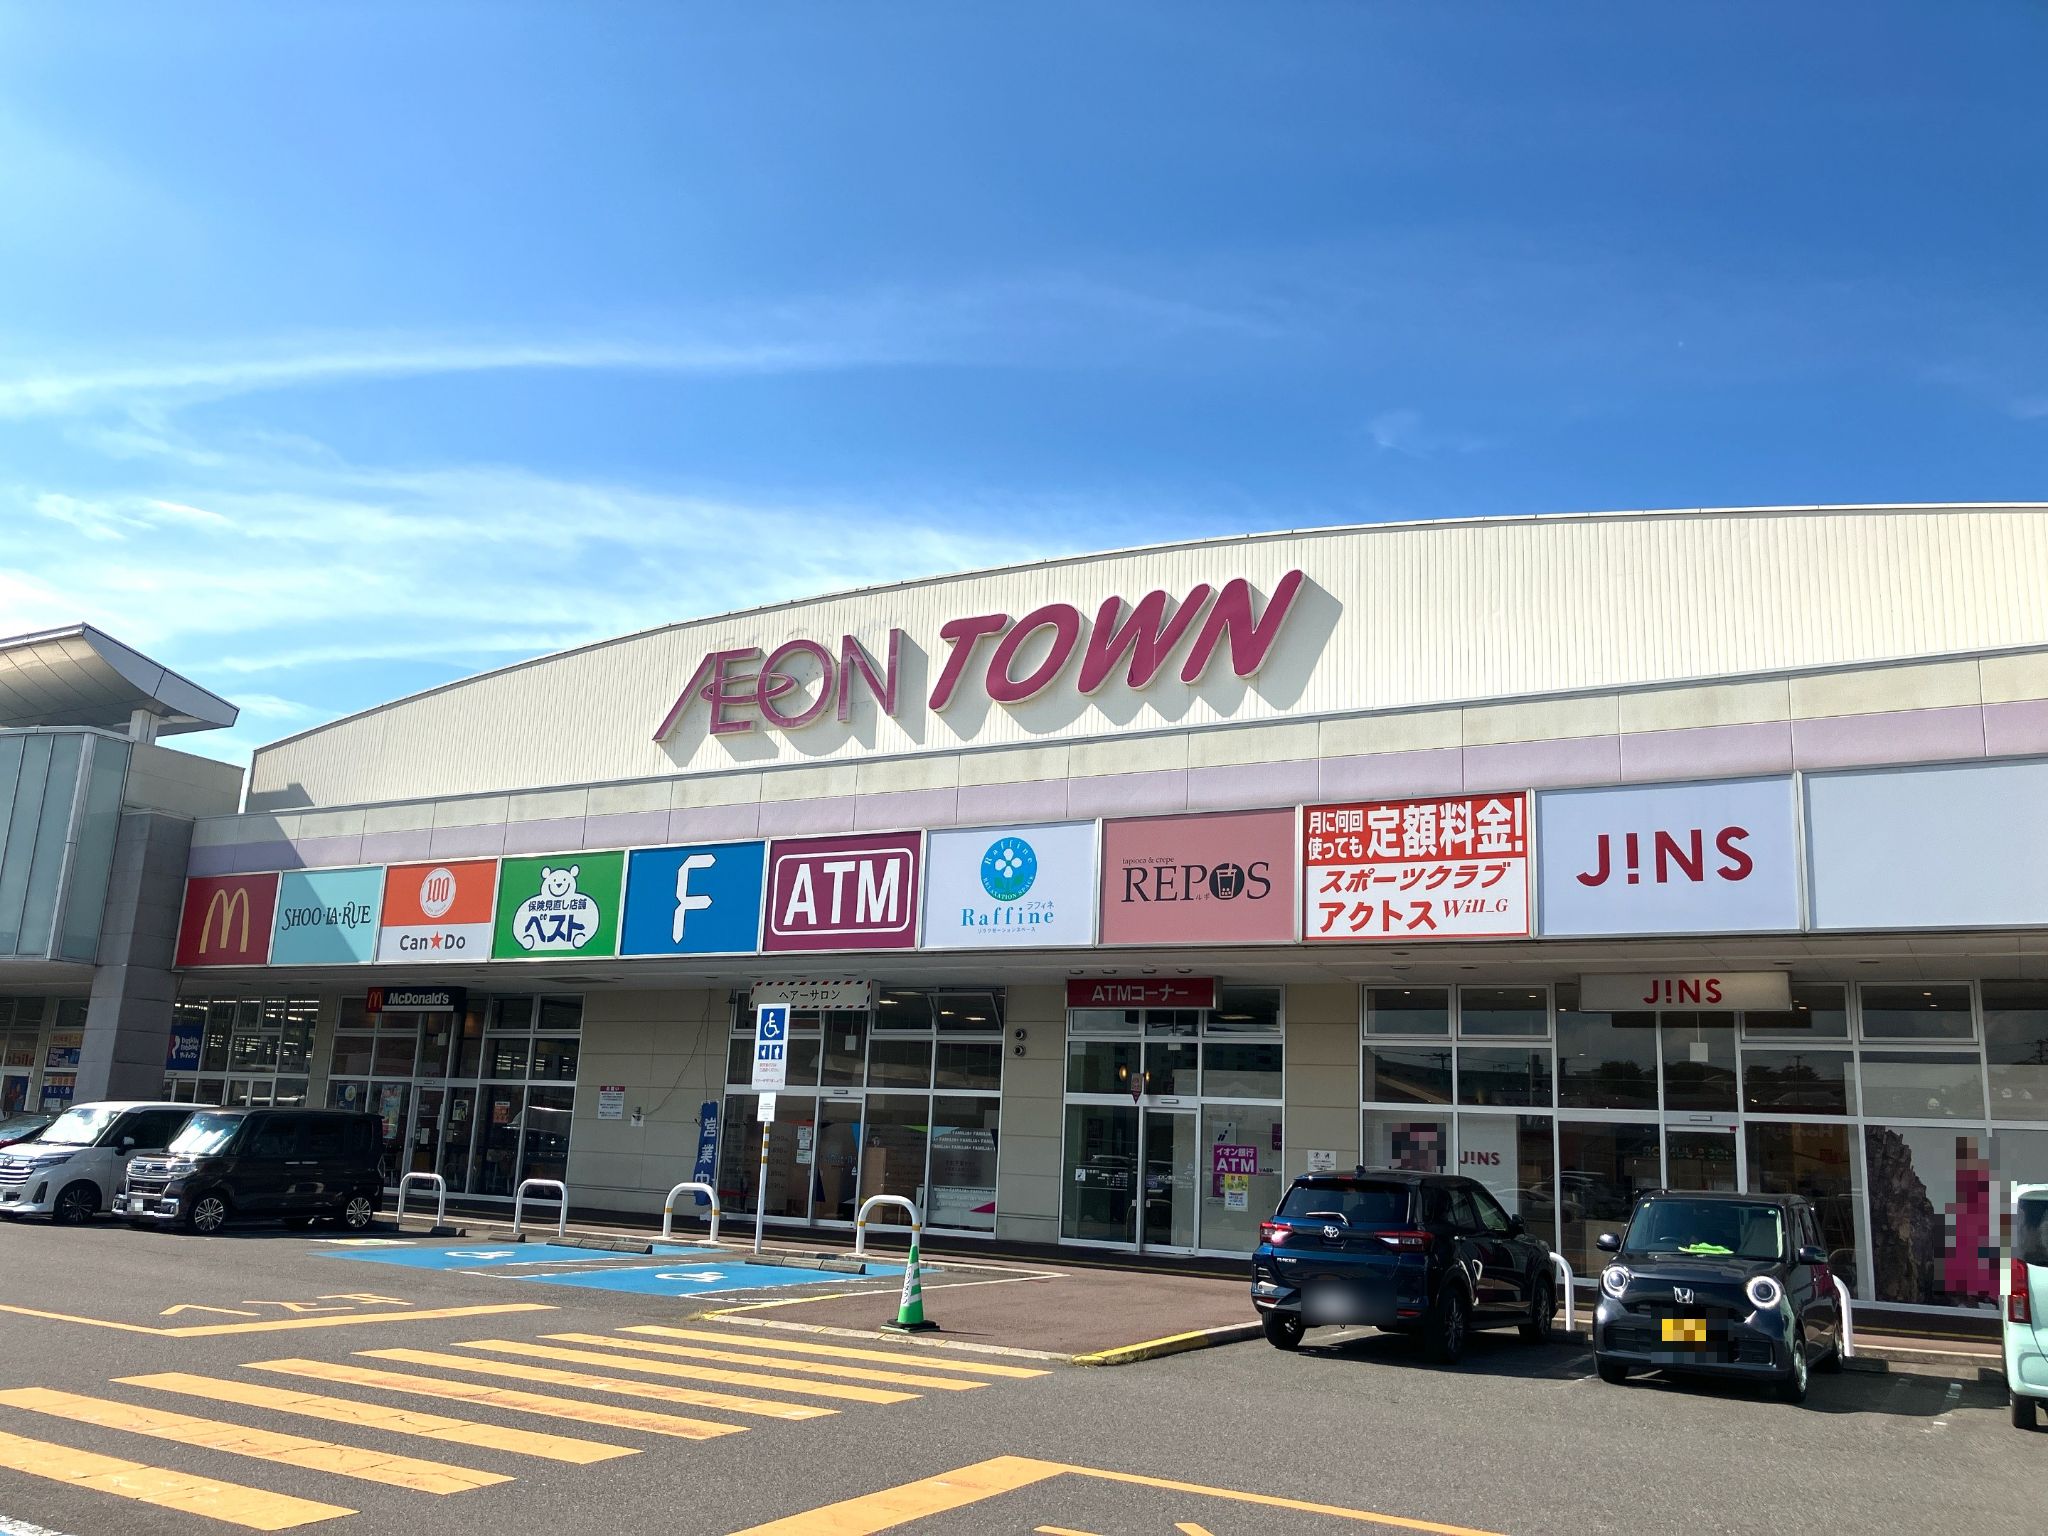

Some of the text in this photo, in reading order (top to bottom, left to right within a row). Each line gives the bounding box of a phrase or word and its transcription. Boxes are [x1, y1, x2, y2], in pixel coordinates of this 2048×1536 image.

[928, 568, 1305, 712] TOWN
[1308, 810, 1364, 834] 月に何回
[1366, 797, 1524, 858] 定額料金!
[1308, 836, 1363, 860] 使っても
[1121, 862, 1271, 902] REPOS
[1319, 861, 1511, 893] スポーツクラブ
[426, 877, 450, 903] 100
[783, 858, 900, 925] ATM
[528, 898, 587, 912] 保険見直し店舗
[961, 906, 1055, 927] Raffine
[1027, 901, 1055, 910] ラフィネ
[1318, 900, 1437, 933] アクトス
[525, 914, 586, 943] ベスト
[388, 991, 449, 1005] McDonald's
[779, 989, 841, 1001] ヘアーサロン
[1092, 984, 1188, 1002] ATMコーナー
[1216, 1148, 1255, 1158] イオン銀行
[1217, 1158, 1255, 1173] ATM
